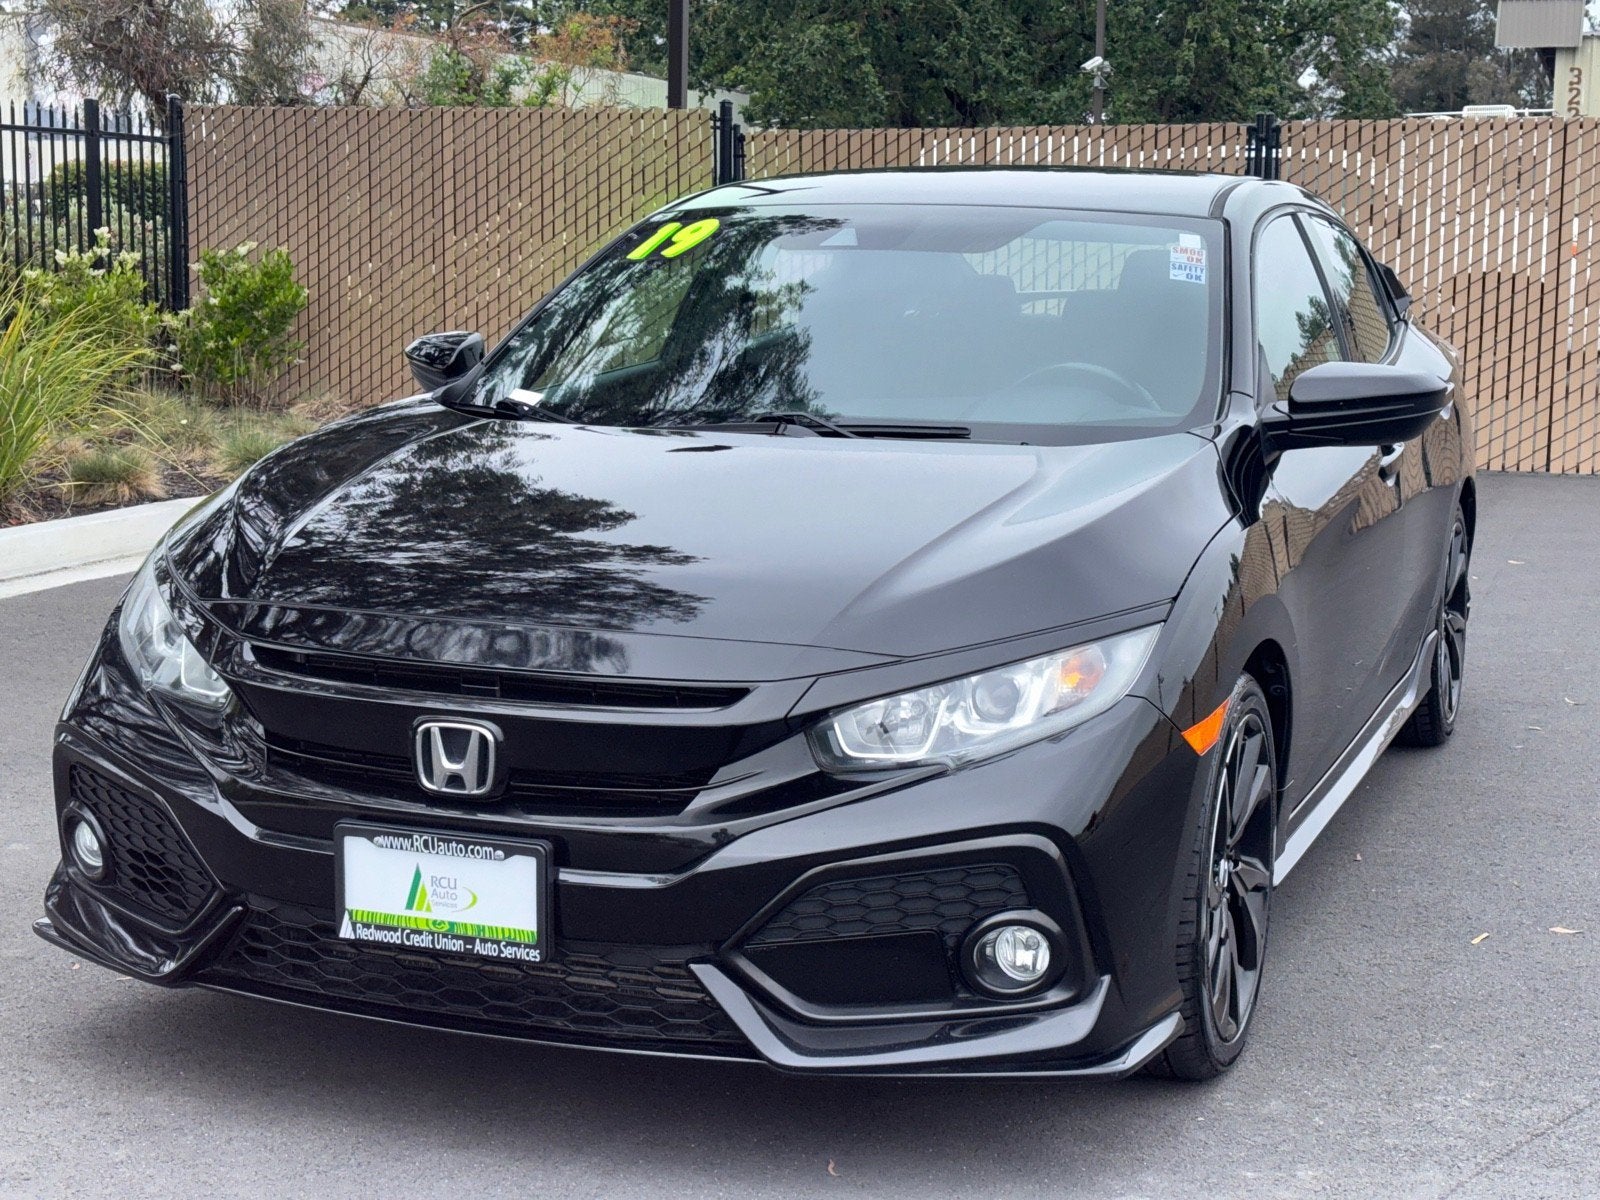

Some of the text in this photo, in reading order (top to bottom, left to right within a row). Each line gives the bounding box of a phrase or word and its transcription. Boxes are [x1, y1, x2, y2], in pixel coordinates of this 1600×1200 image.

[626, 218, 720, 260] 19
[1186, 256, 1203, 264] OK
[1171, 262, 1204, 274] SAFETY
[1186, 272, 1203, 281] OK
[381, 835, 494, 860] www.RCUauto.com
[430, 875, 457, 890] RCU
[431, 888, 458, 900] Auto
[356, 924, 401, 944] Redwood
[403, 930, 433, 949] Credit
[434, 936, 464, 952] Union
[474, 940, 499, 957] Auto
[500, 941, 541, 962] Services
